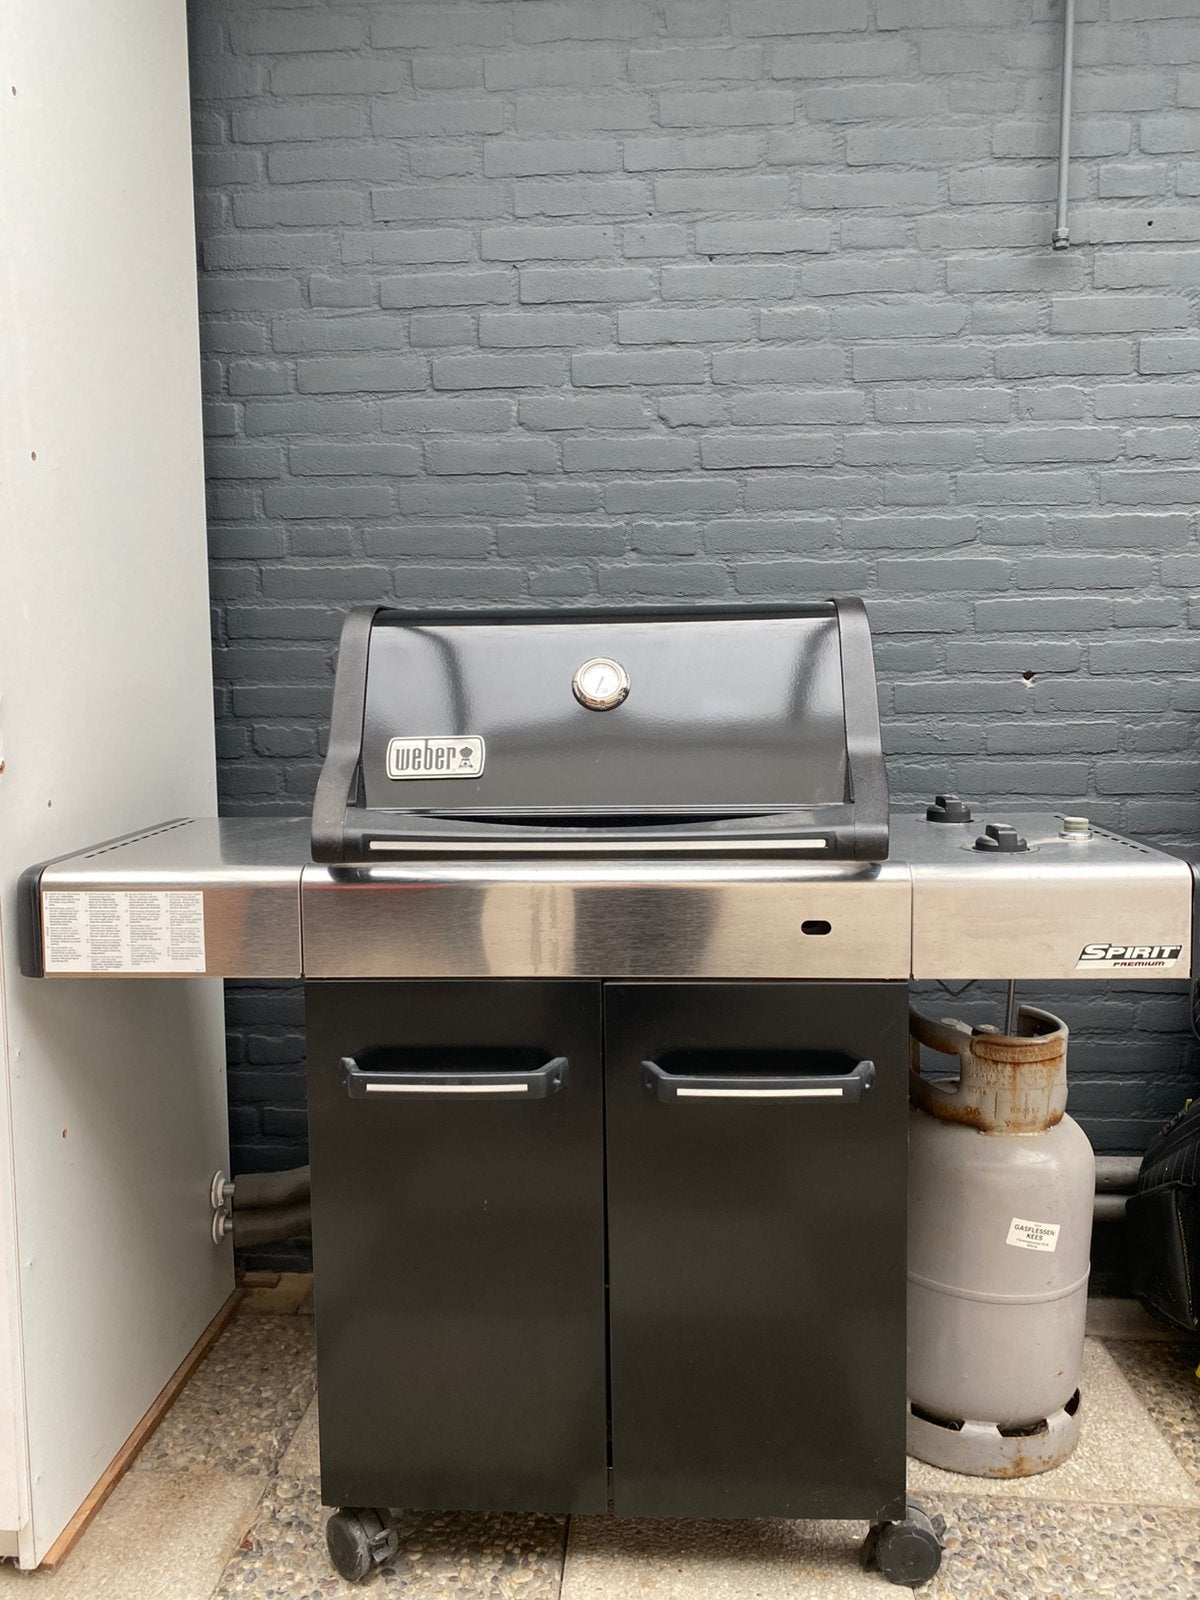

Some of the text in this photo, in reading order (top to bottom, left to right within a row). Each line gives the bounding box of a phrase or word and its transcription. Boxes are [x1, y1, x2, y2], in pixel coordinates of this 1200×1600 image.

[395, 739, 456, 770] weber
[1080, 944, 1179, 960] SPIRIT
[1014, 1224, 1055, 1236] GASFLESSEN
[1026, 1233, 1043, 1241] KEES
